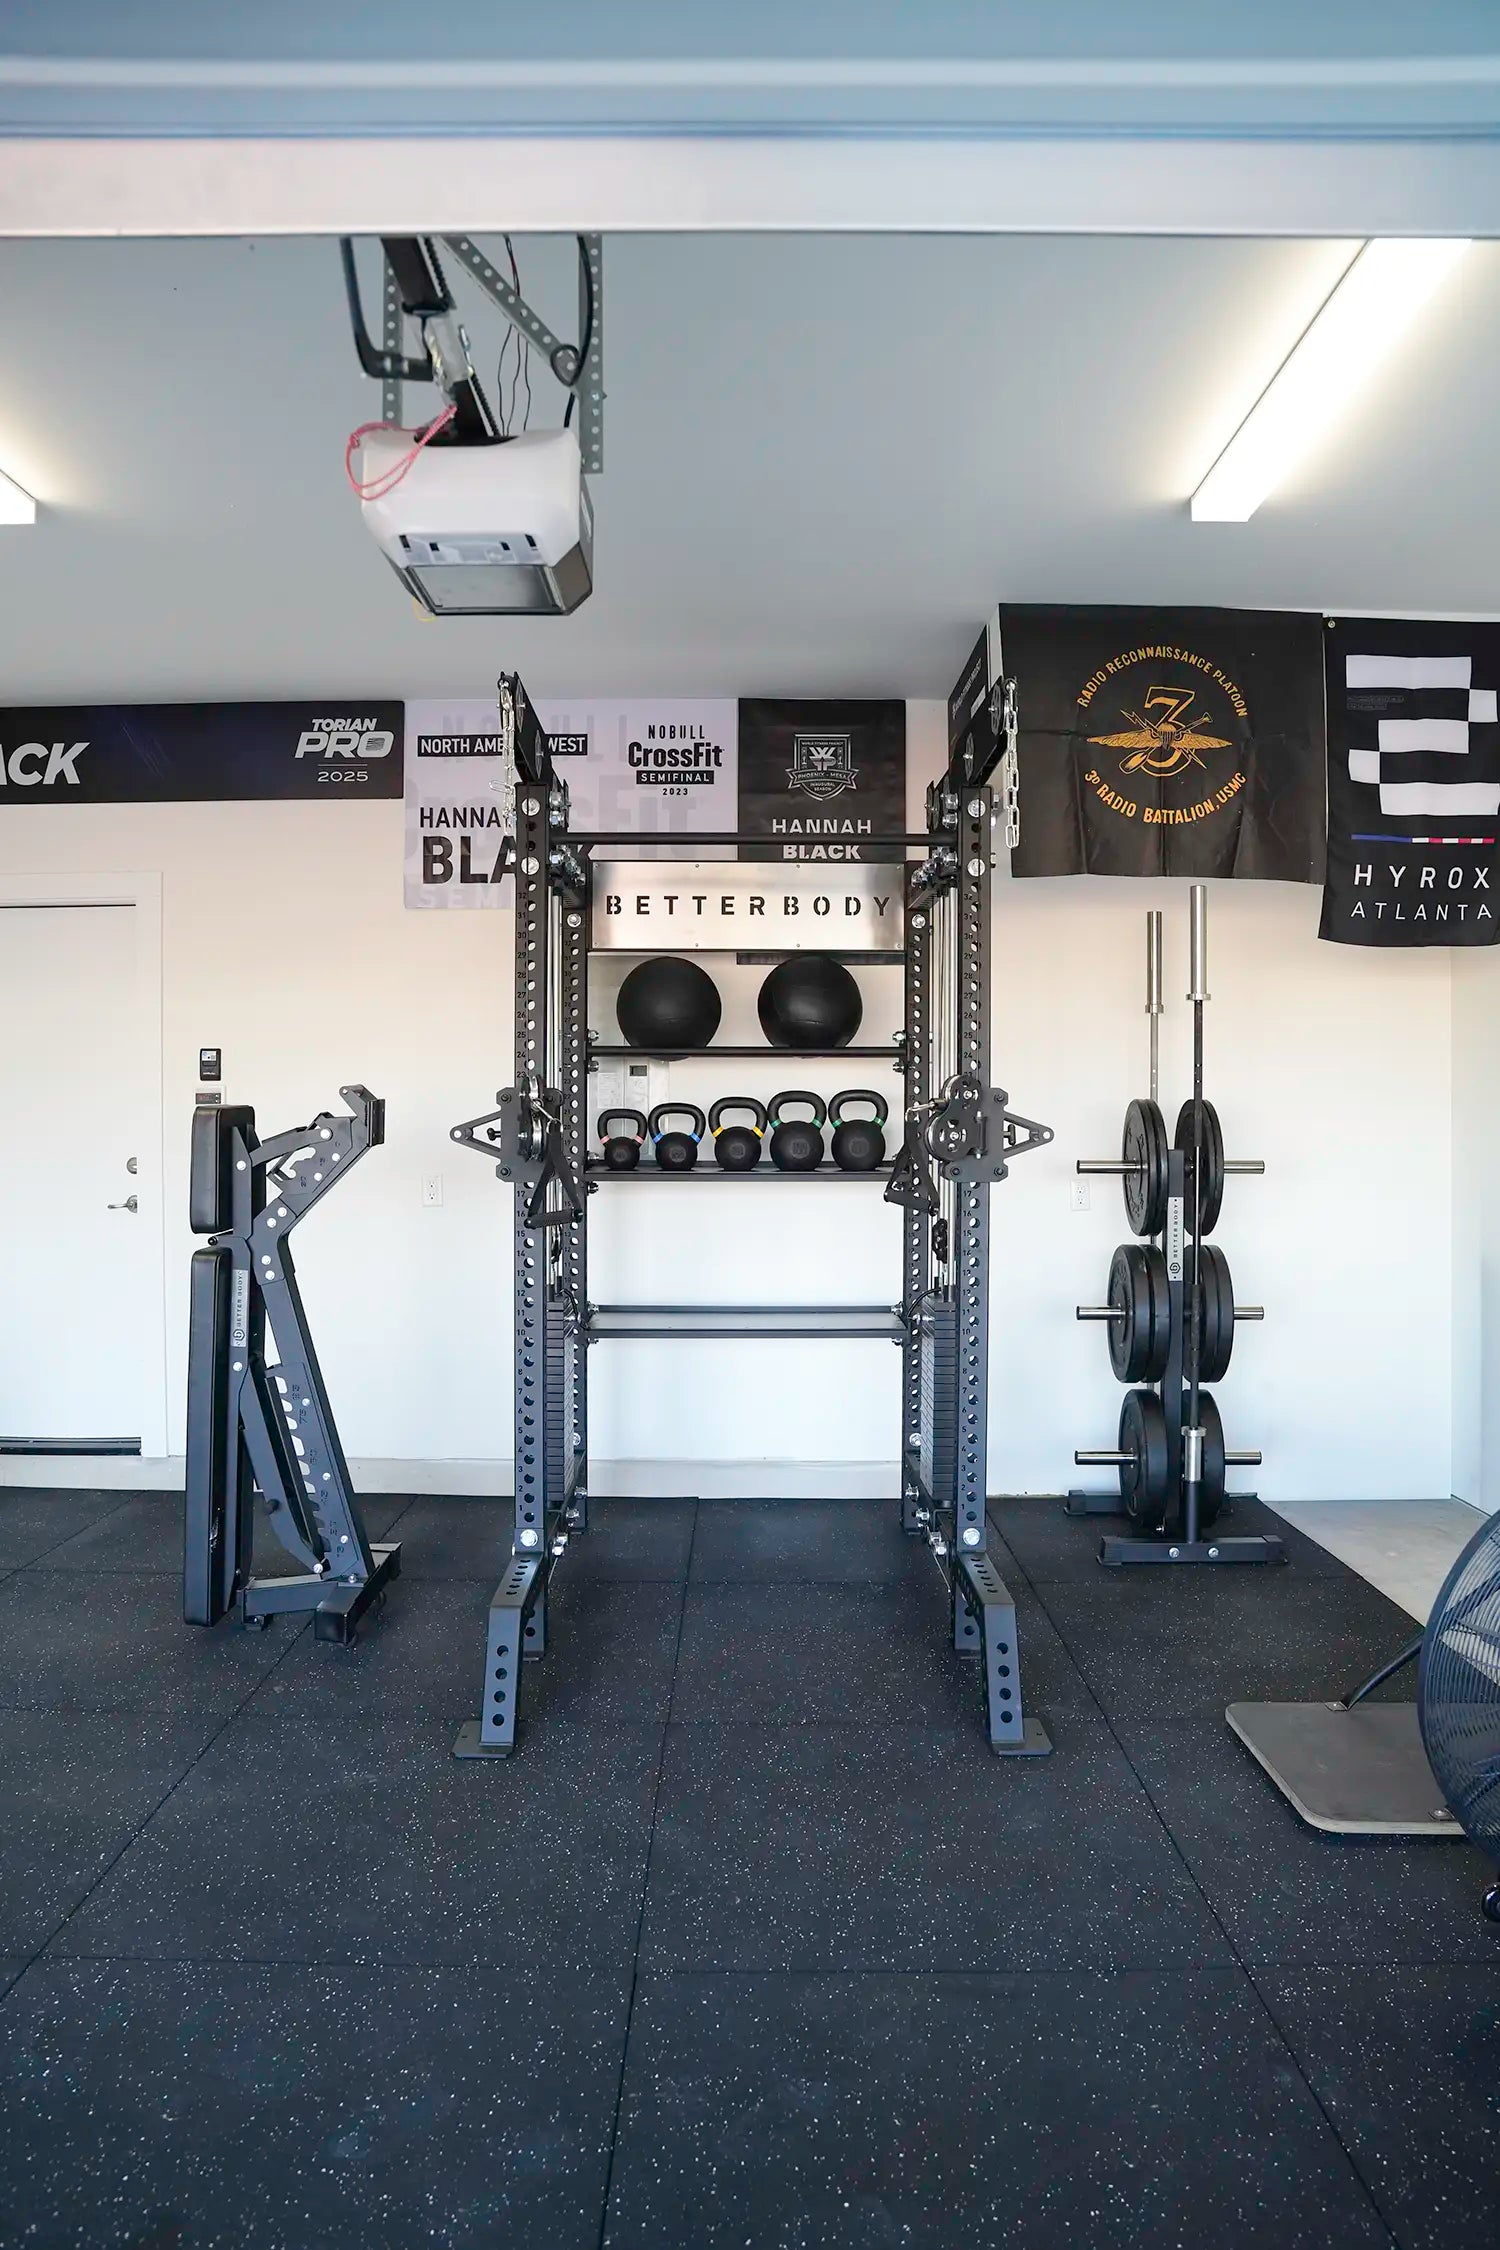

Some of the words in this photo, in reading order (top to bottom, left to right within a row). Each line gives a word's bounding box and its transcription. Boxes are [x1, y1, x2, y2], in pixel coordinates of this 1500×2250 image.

[1077, 671, 1107, 708] RADIO
[1105, 646, 1213, 673] RECONNAISSANCE
[1212, 669, 1248, 717] PLATOON
[311, 718, 378, 732] TORIAN
[648, 724, 705, 739] NOBULL
[294, 731, 394, 758] PRO
[420, 738, 470, 754] NORTH
[548, 737, 586, 752] WEST
[628, 741, 723, 767] CrossFit
[0, 742, 91, 786] CK
[317, 771, 369, 782] 2025
[641, 773, 710, 782] SEMIFINAL
[662, 787, 688, 796] 2023
[1096, 783, 1137, 818] RADIO
[1143, 798, 1220, 825] BATTALION,
[1215, 772, 1247, 804] USMC
[420, 806, 504, 829] HANNA
[772, 819, 872, 834] HANNAH
[422, 835, 518, 884] BLA
[783, 844, 861, 860] BLACK
[1353, 864, 1490, 889] HYROX
[1350, 901, 1492, 921] ATLANTA
